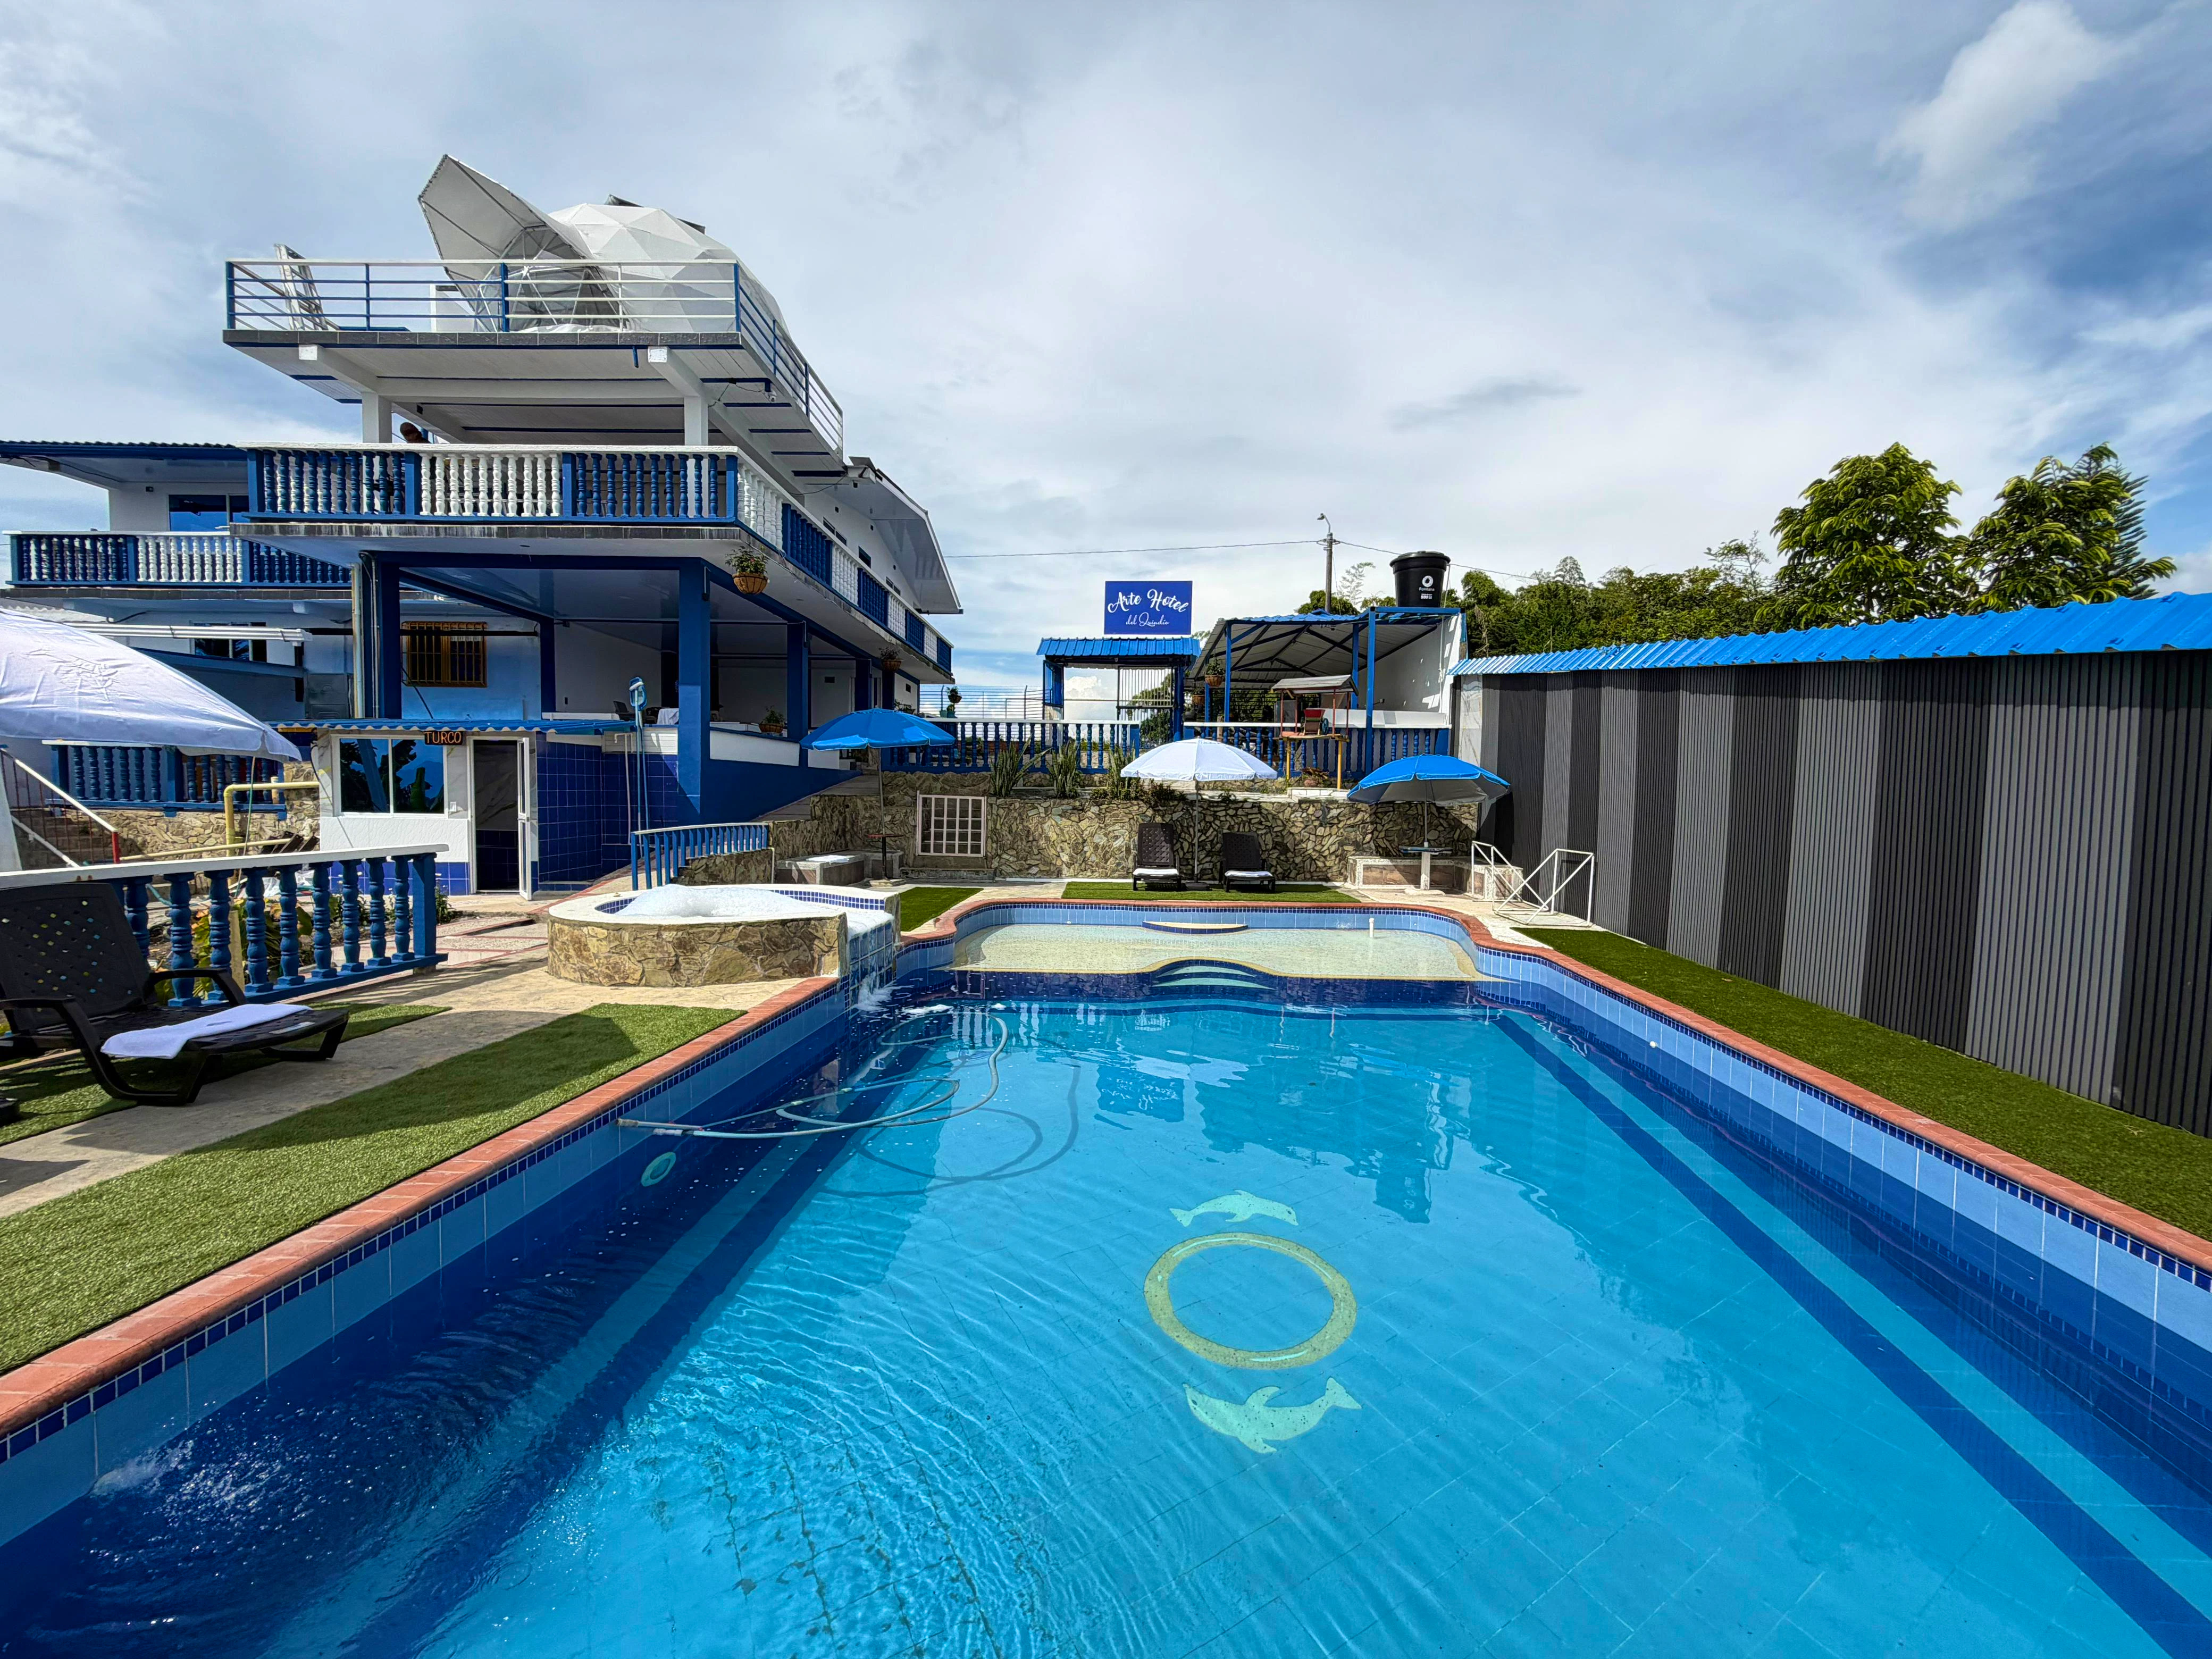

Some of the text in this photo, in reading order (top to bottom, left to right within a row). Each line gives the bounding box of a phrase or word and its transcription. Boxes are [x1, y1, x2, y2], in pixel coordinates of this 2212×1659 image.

[1108, 589, 1189, 613] Arte Hotel
[1126, 614, 1137, 625] del
[424, 731, 462, 743] TURCO
